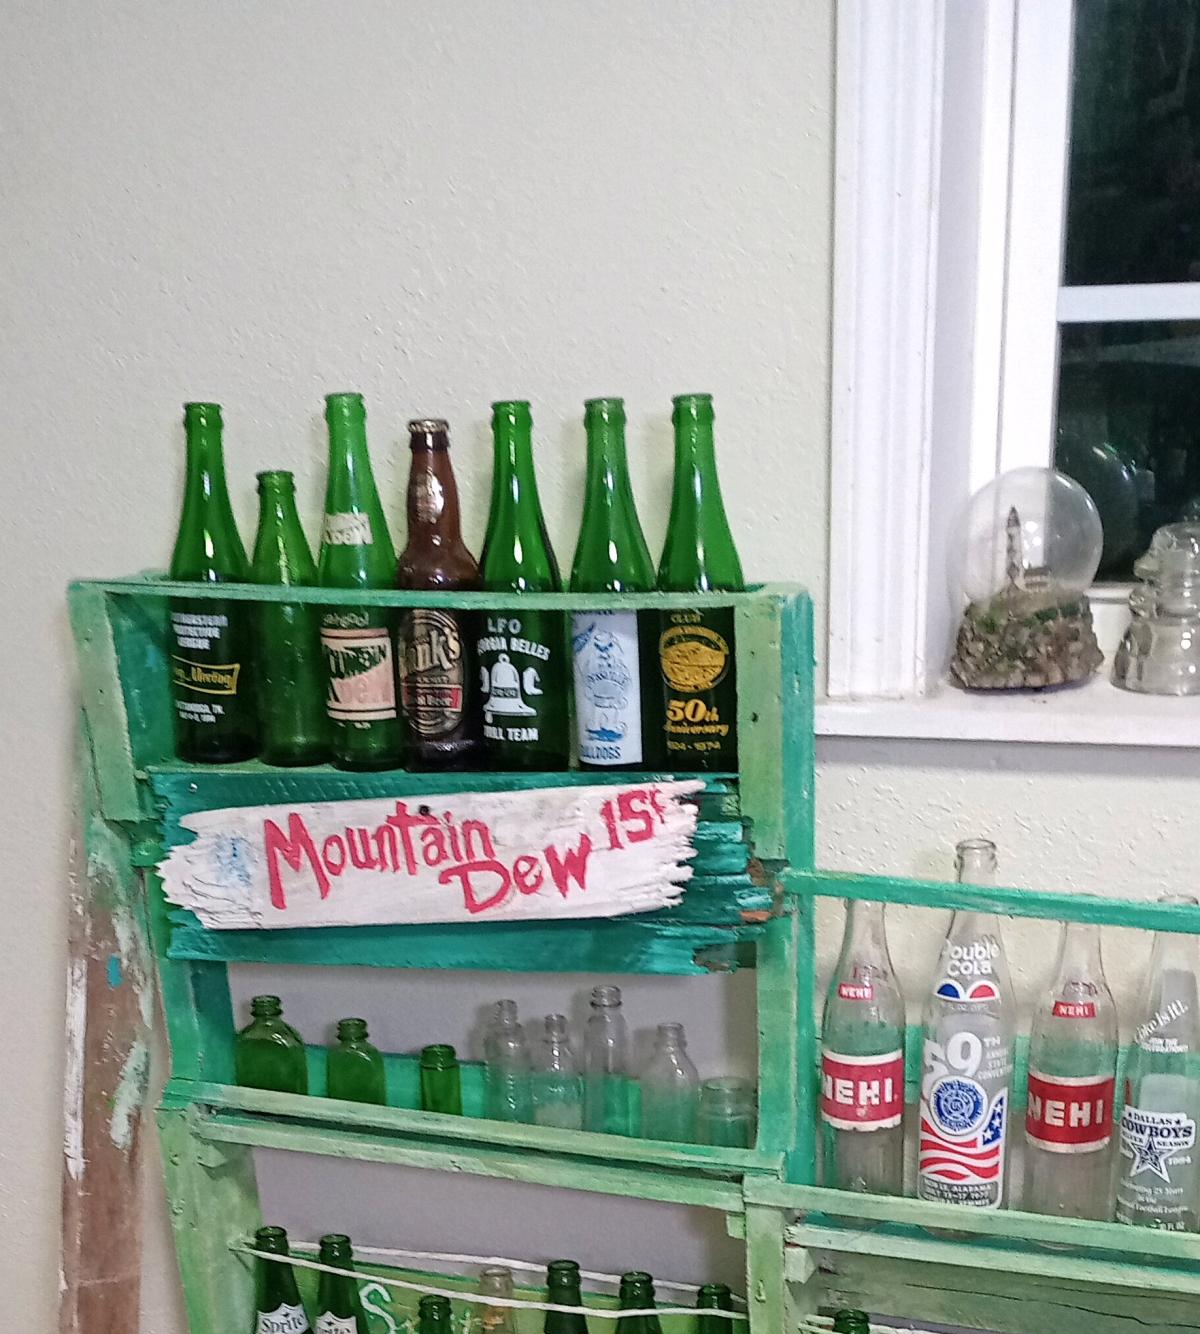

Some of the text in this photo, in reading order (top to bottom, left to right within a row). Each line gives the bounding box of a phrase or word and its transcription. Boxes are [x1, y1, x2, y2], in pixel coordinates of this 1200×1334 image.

[487, 617, 521, 634] LFO
[510, 637, 550, 661] BELLES
[666, 698, 720, 722] 50th
[506, 727, 539, 742] TEAM
[264, 801, 496, 911] Mountain
[439, 833, 592, 914] Dew
[1059, 1004, 1089, 1016] NEHI
[823, 1077, 892, 1107] NEHI
[1028, 1091, 1104, 1128] NEHI
[1134, 1112, 1173, 1126] DALLAS
[1121, 1116, 1193, 1138] COWBOYS
